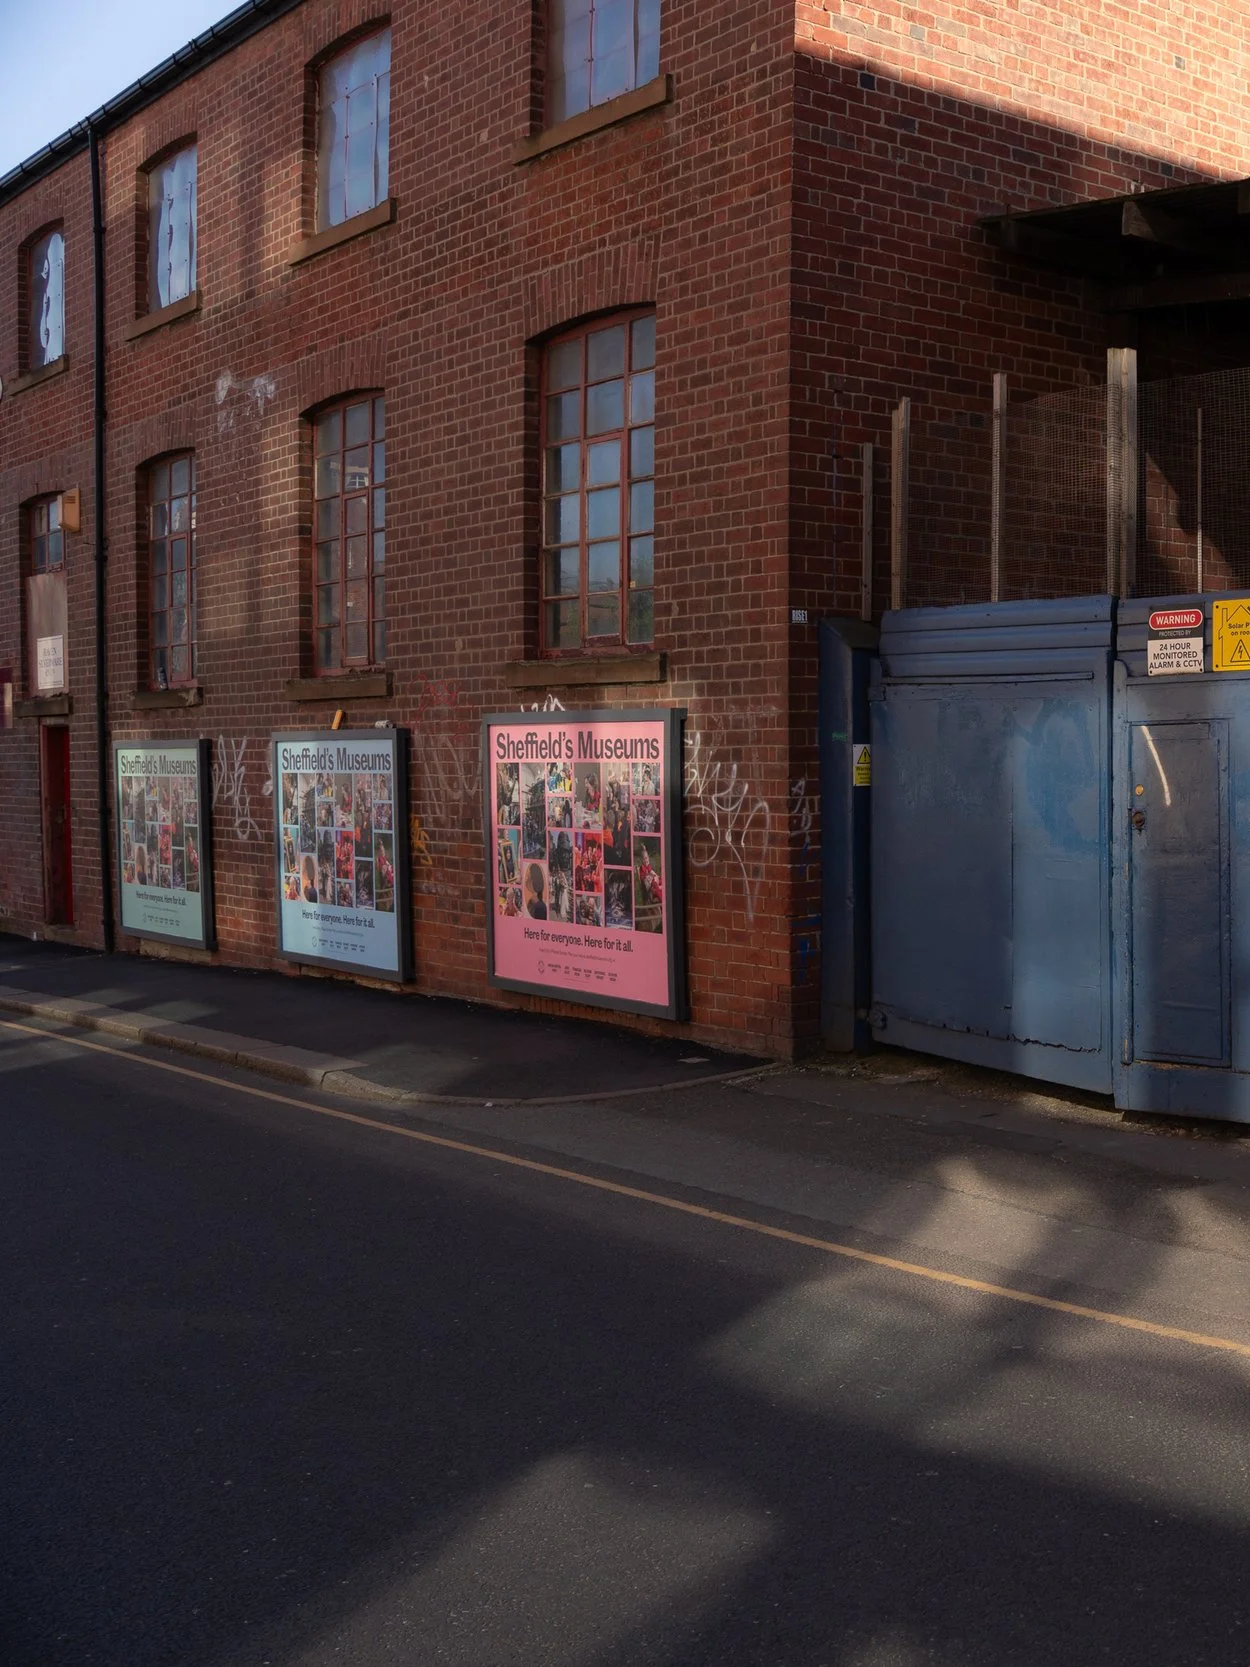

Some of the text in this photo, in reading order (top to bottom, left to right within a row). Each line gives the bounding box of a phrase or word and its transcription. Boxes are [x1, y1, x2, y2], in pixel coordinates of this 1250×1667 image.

[1156, 614, 1196, 625] WARNING
[1153, 650, 1198, 660] MONITORED
[1170, 642, 1191, 650] HOUR
[1149, 661, 1174, 670] ALARM
[1184, 660, 1203, 668] CCTV
[496, 730, 660, 760] Sheffield's Museums
[120, 755, 196, 774] Sheffield's Museums
[282, 747, 391, 770] Sheffield's Museums
[302, 909, 313, 919] Here
[321, 914, 342, 924] everyone.
[343, 915, 355, 925] Here
[363, 917, 367, 927] it
[524, 928, 634, 952] Here for everyone. Here for it all.
